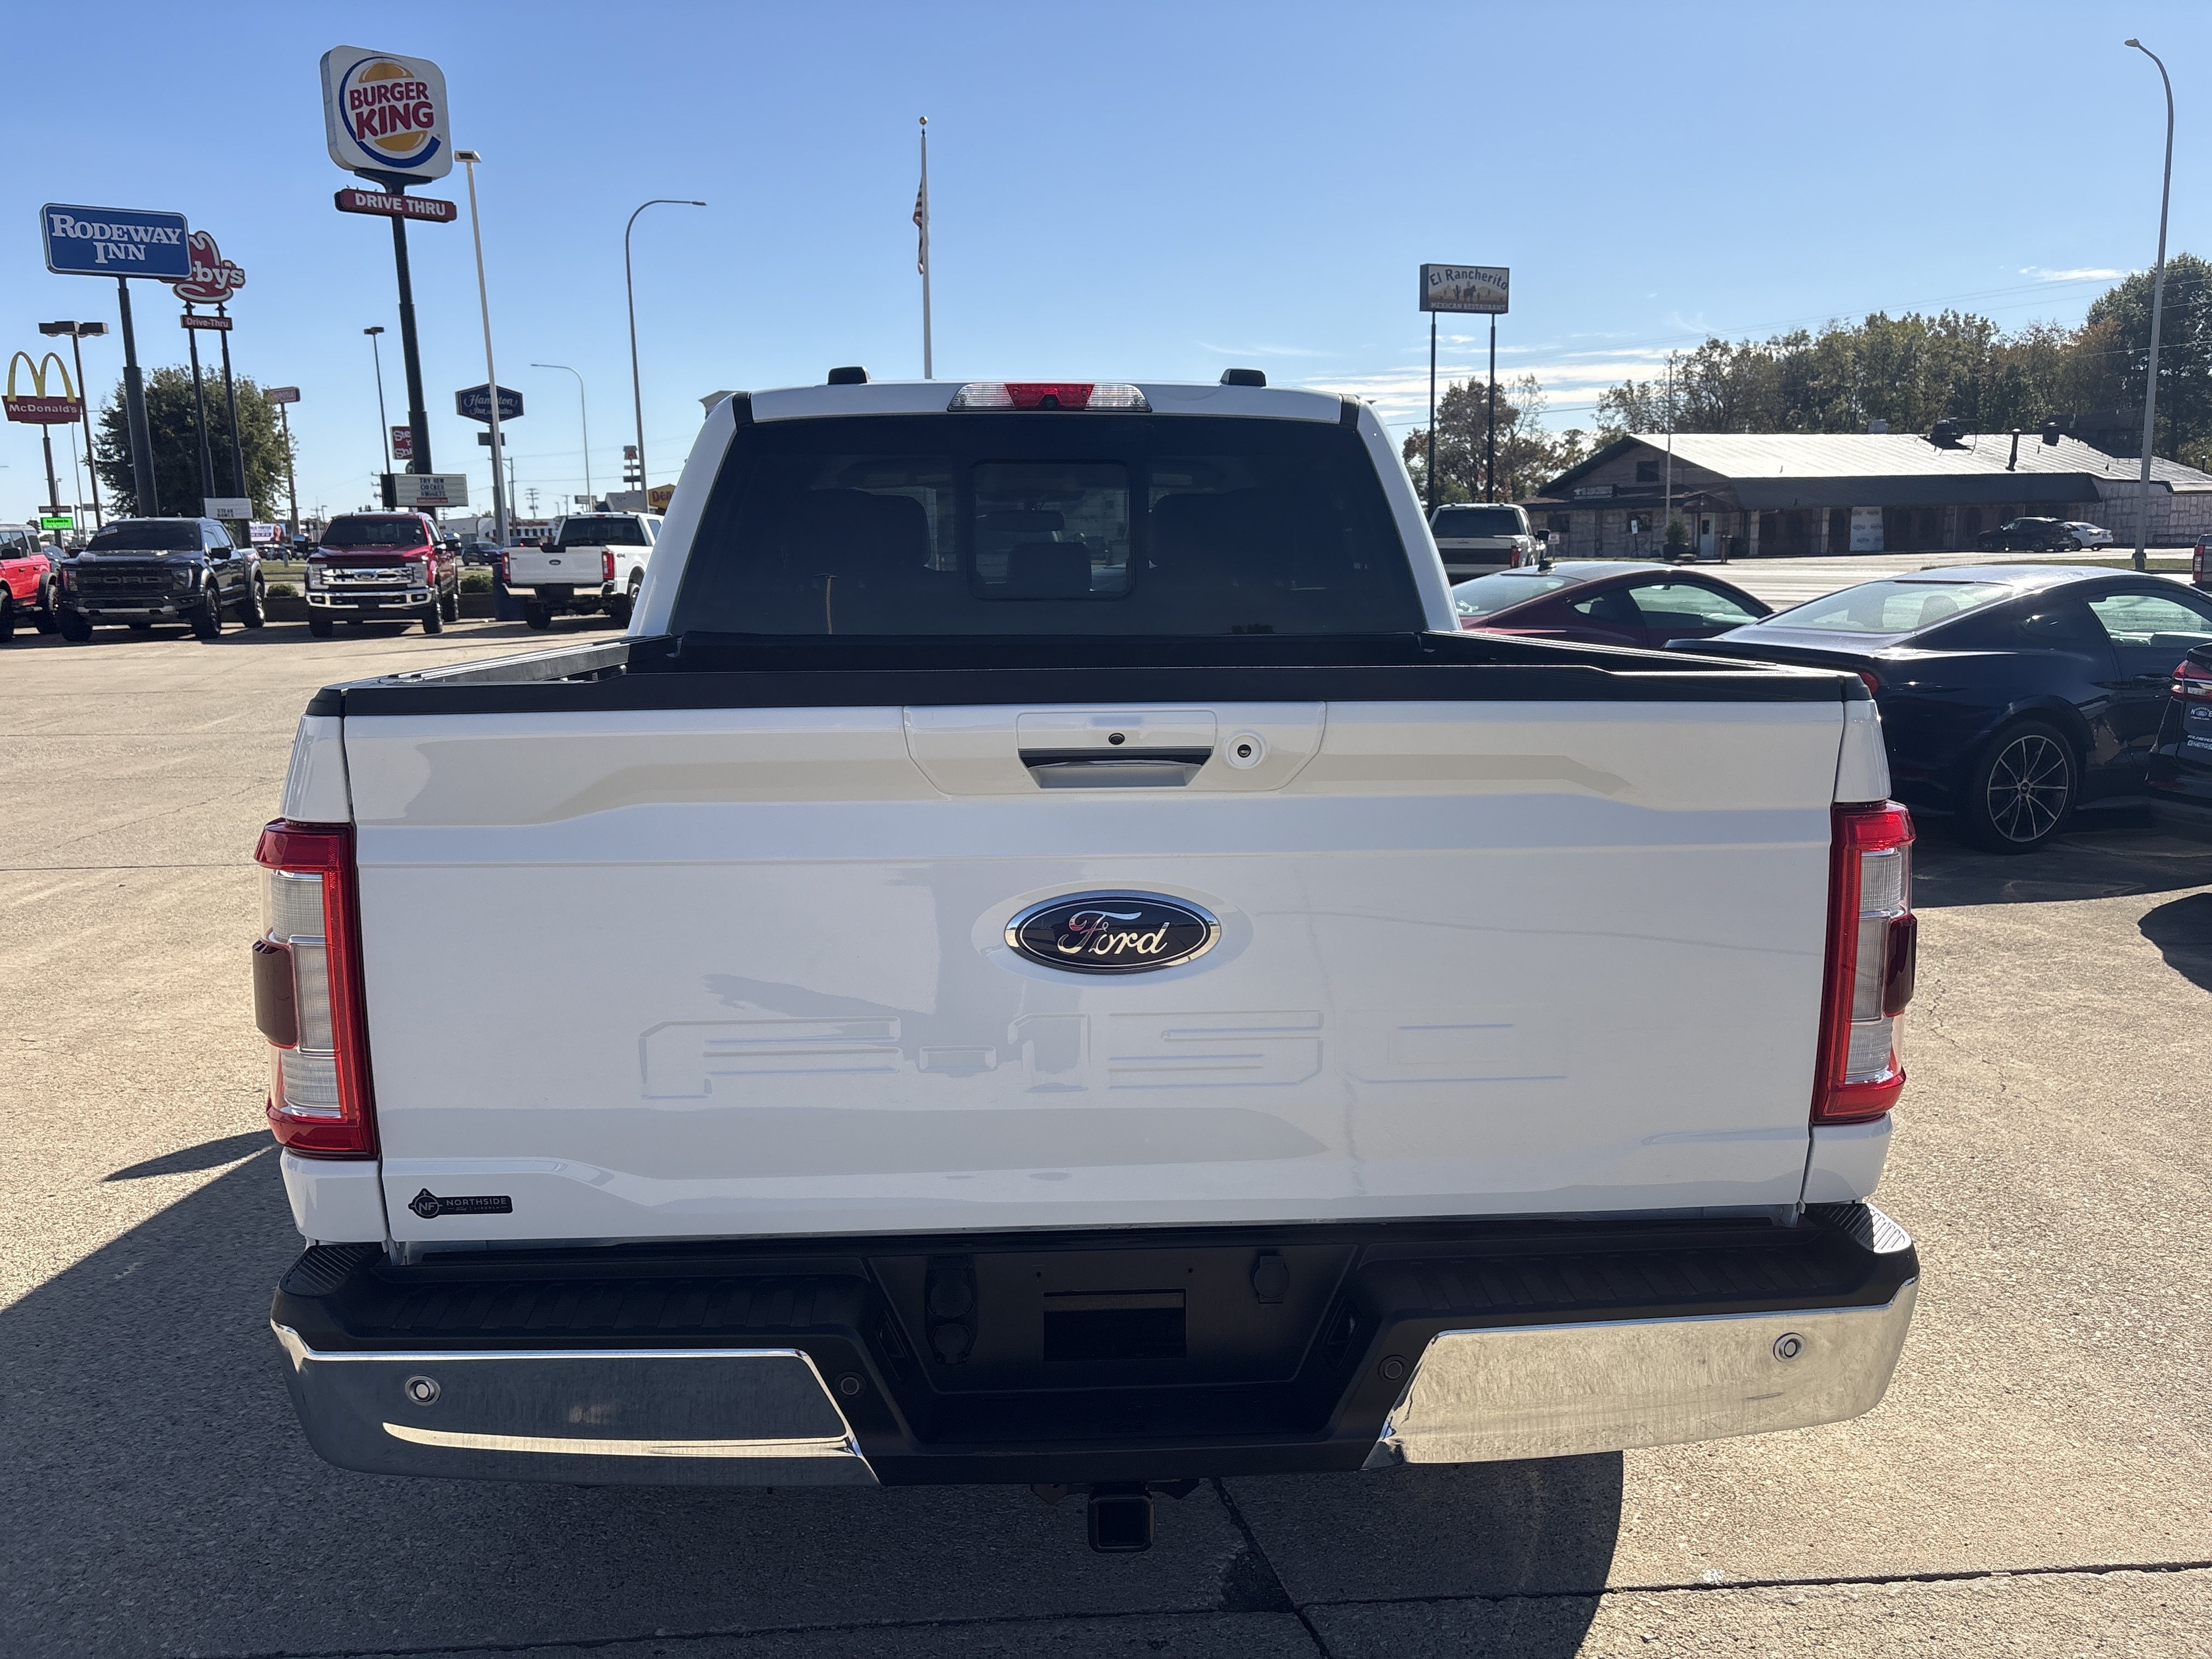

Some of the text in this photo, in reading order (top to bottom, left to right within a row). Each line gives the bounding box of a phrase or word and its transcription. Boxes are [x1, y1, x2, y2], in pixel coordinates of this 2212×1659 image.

[349, 82, 429, 111] BURGER
[355, 101, 434, 141] KING
[355, 193, 446, 216] DRIVE THRU
[49, 214, 182, 245] RODEWAY
[93, 241, 146, 264] INN
[185, 261, 244, 290] by's
[1430, 268, 1508, 290] El Rancherito
[187, 317, 229, 328] Drive-Thru
[9, 404, 77, 413] McDonald's
[464, 394, 518, 408] Hamton
[1057, 910, 1170, 956] Ford
[639, 1009, 1567, 1101] F-150
[446, 1198, 507, 1206] NORTHSIDE
